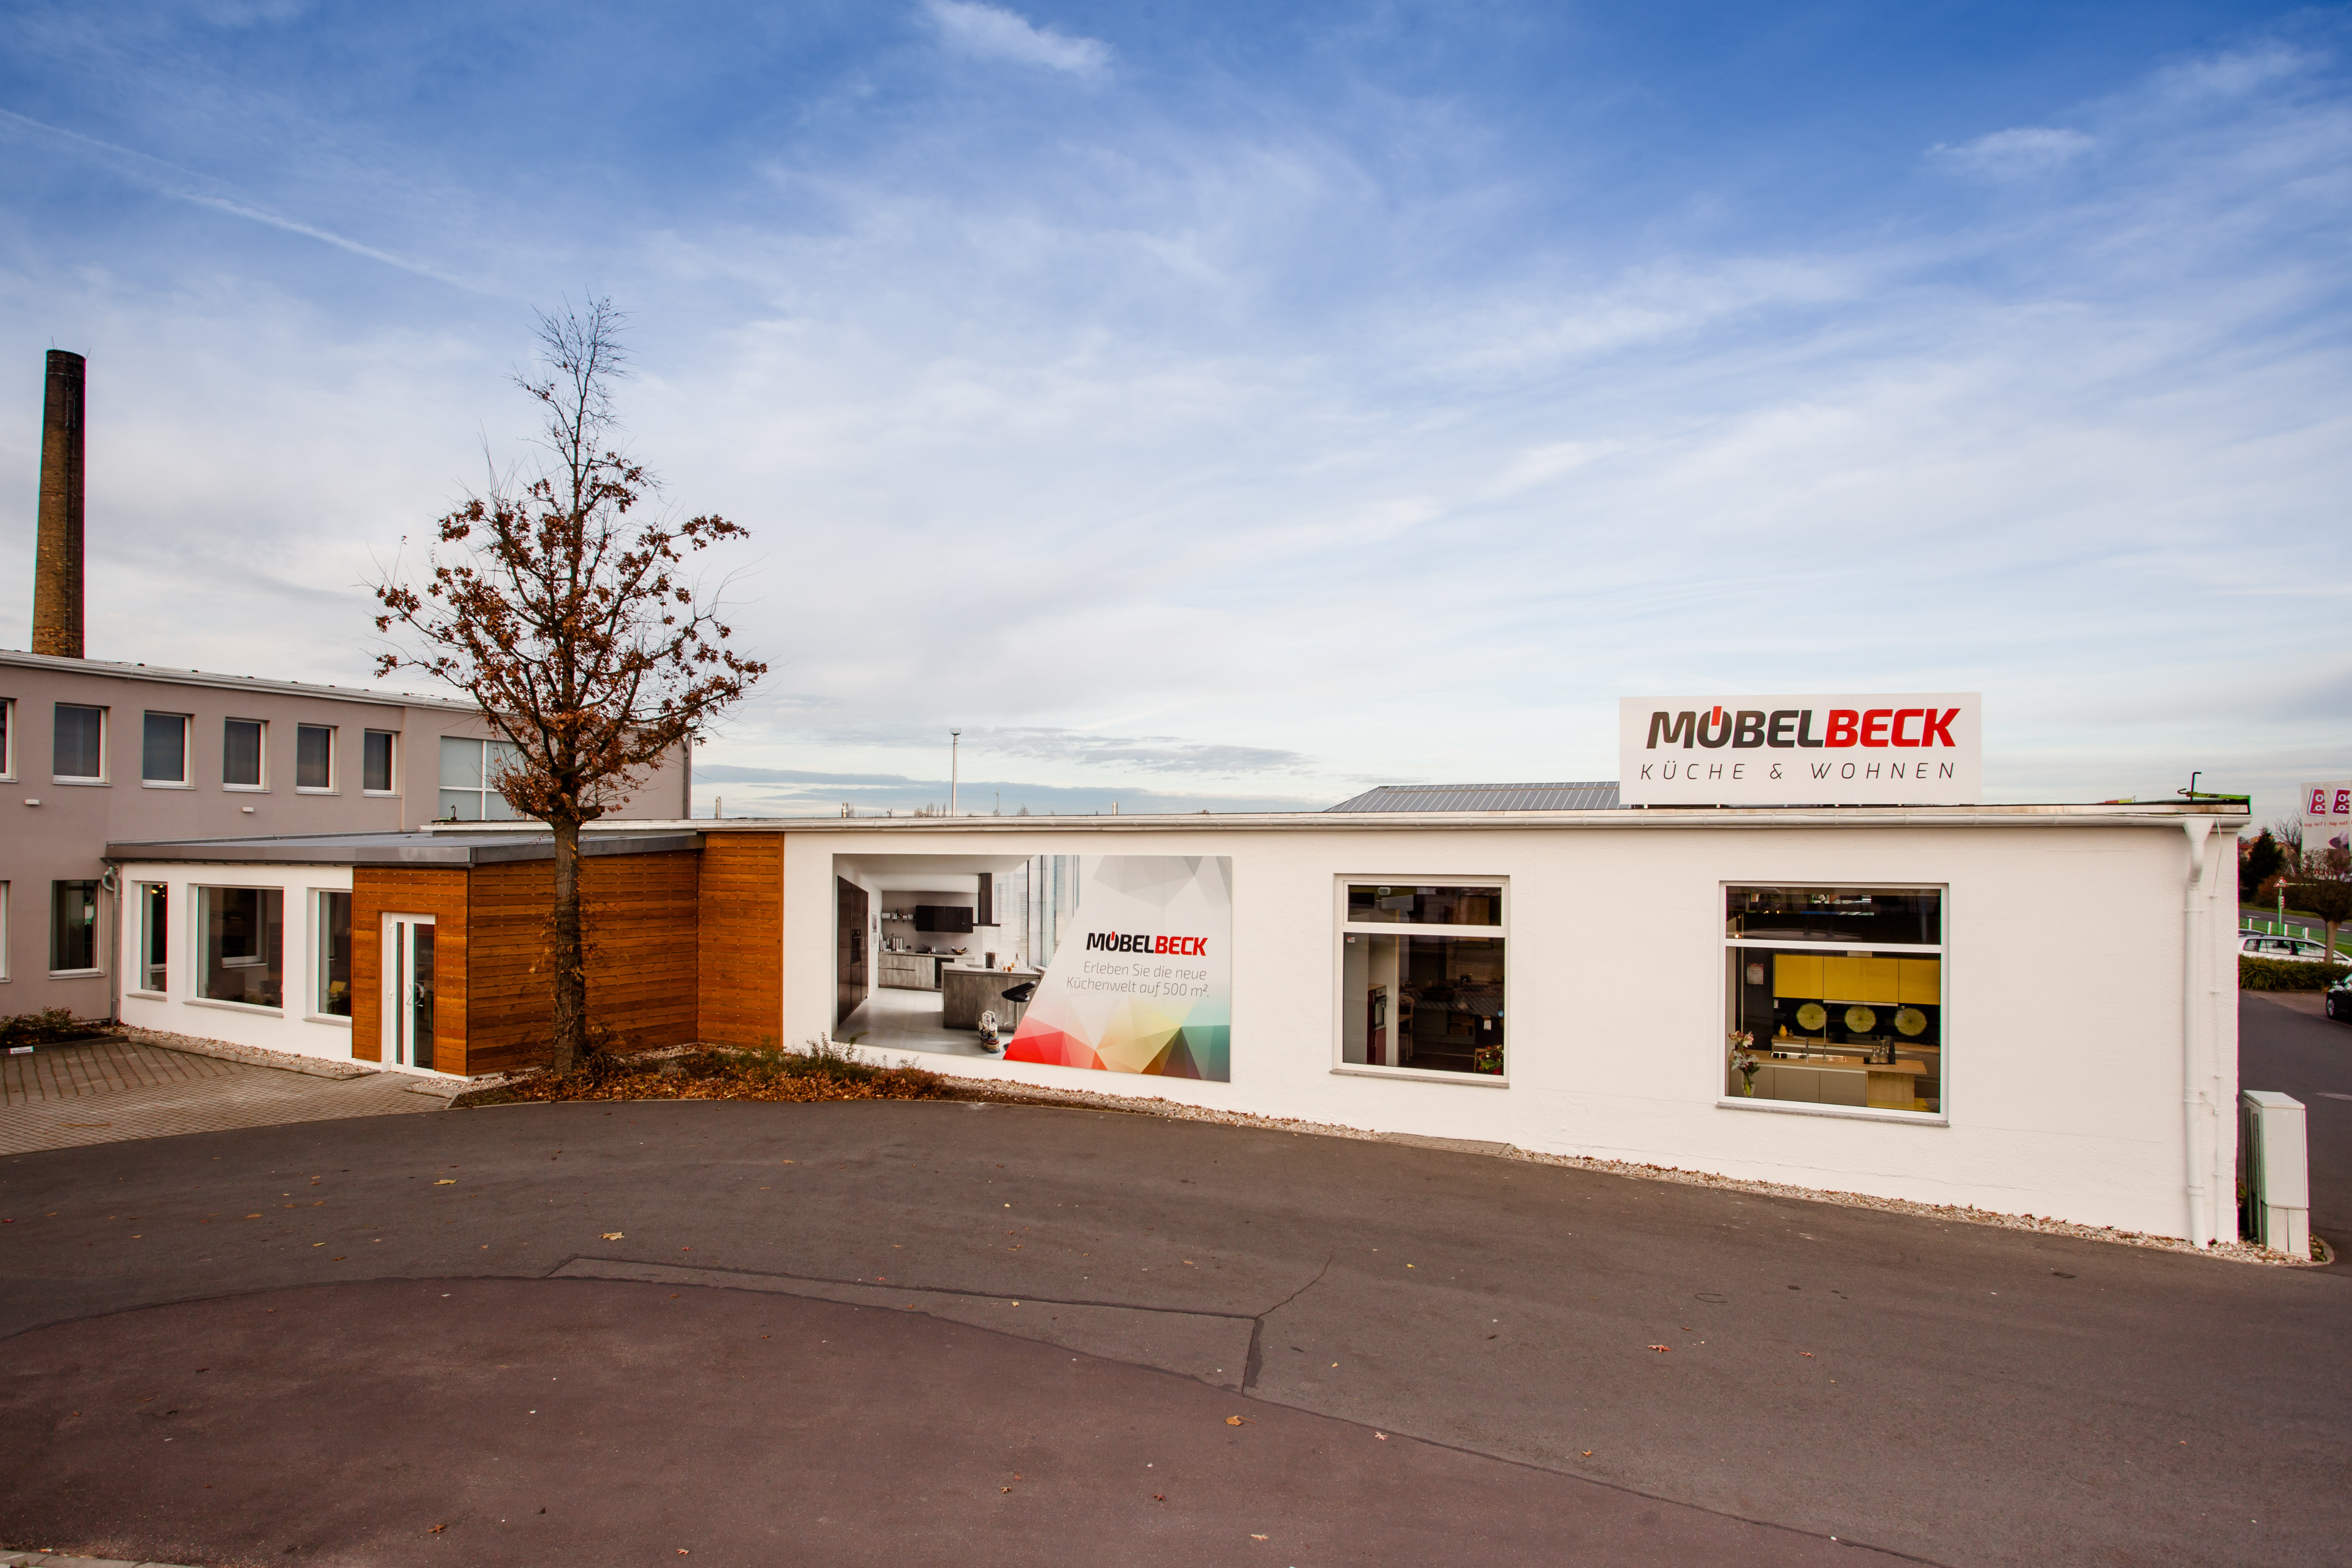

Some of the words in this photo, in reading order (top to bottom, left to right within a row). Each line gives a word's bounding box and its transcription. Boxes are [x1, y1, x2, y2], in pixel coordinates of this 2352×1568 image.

[1641, 760, 1745, 780] KÜCHE
[1769, 763, 1783, 779] &
[1811, 762, 1954, 779] WOHNEN
[1083, 961, 1129, 975] Erleben
[1132, 964, 1151, 977] Sie
[1154, 965, 1172, 978] die
[1175, 970, 1207, 980] neue
[1066, 977, 1137, 993] Küchenwelt
[1139, 982, 1161, 997] auf
[1163, 983, 1187, 996] 500
[1190, 984, 1209, 998] m².
